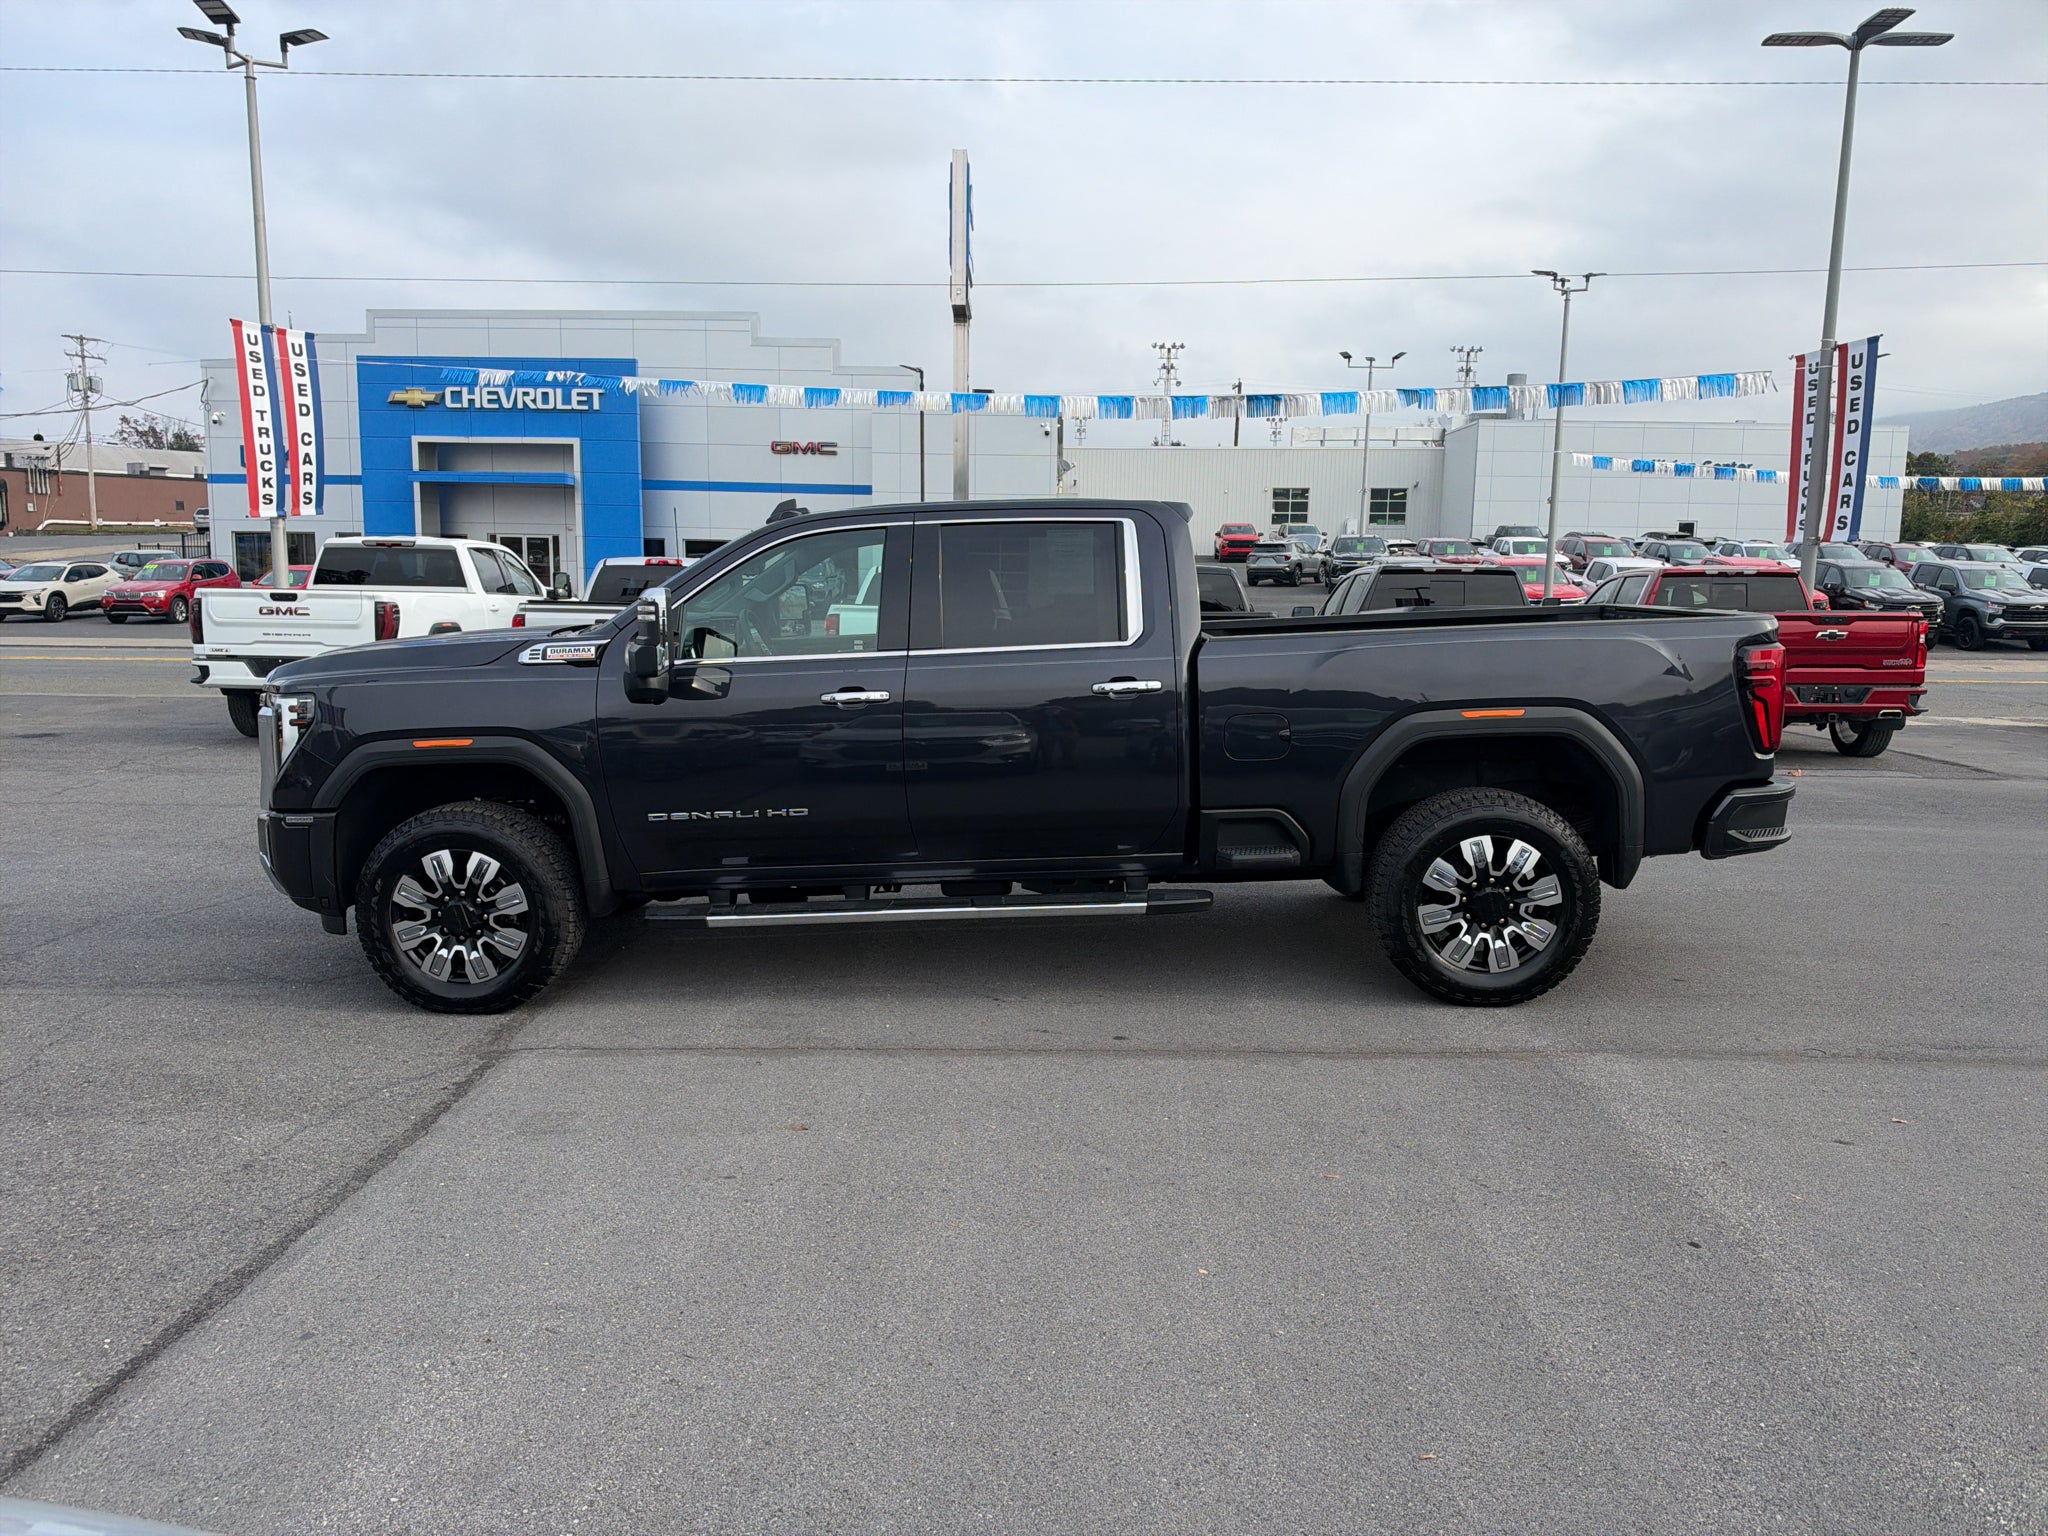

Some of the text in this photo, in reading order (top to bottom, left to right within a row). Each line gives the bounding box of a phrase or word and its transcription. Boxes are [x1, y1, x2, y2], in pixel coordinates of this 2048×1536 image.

[444, 386, 605, 411] CHEVROLET
[247, 333, 274, 506] USED TRUCKS
[291, 342, 313, 505] USED CARS
[770, 441, 838, 456] GMC
[1836, 353, 1864, 531] USED CARS
[258, 606, 310, 616] GMC
[648, 808, 809, 821] DENALI HD
